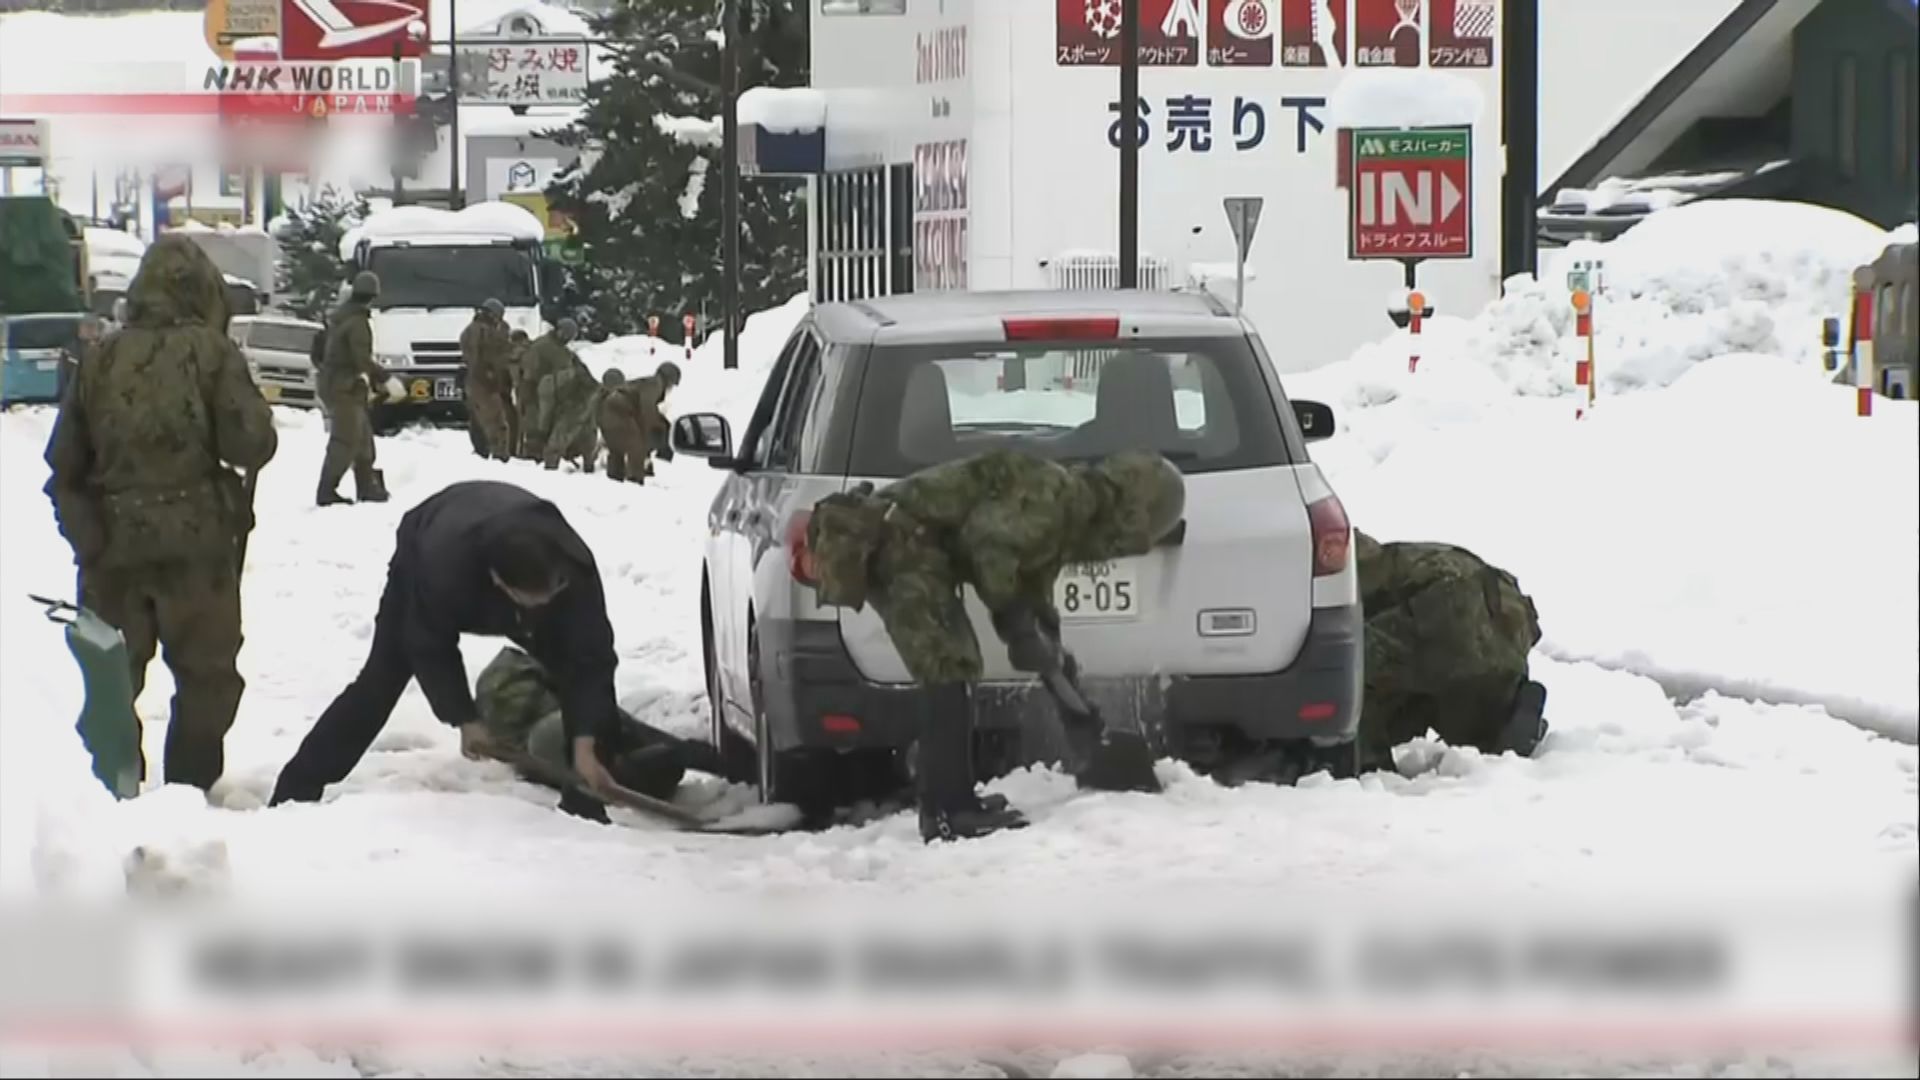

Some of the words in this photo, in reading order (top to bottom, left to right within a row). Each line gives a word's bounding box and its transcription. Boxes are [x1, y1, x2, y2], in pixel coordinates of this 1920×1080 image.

[463, 47, 583, 73] 好み焼
[1058, 45, 1111, 63] スポーツ
[1208, 46, 1248, 63] ホビー
[1431, 48, 1488, 65] ブランド品
[1389, 140, 1463, 152] モスバーガー
[1360, 171, 1432, 225] IN
[1064, 581, 1131, 612] 8-05
